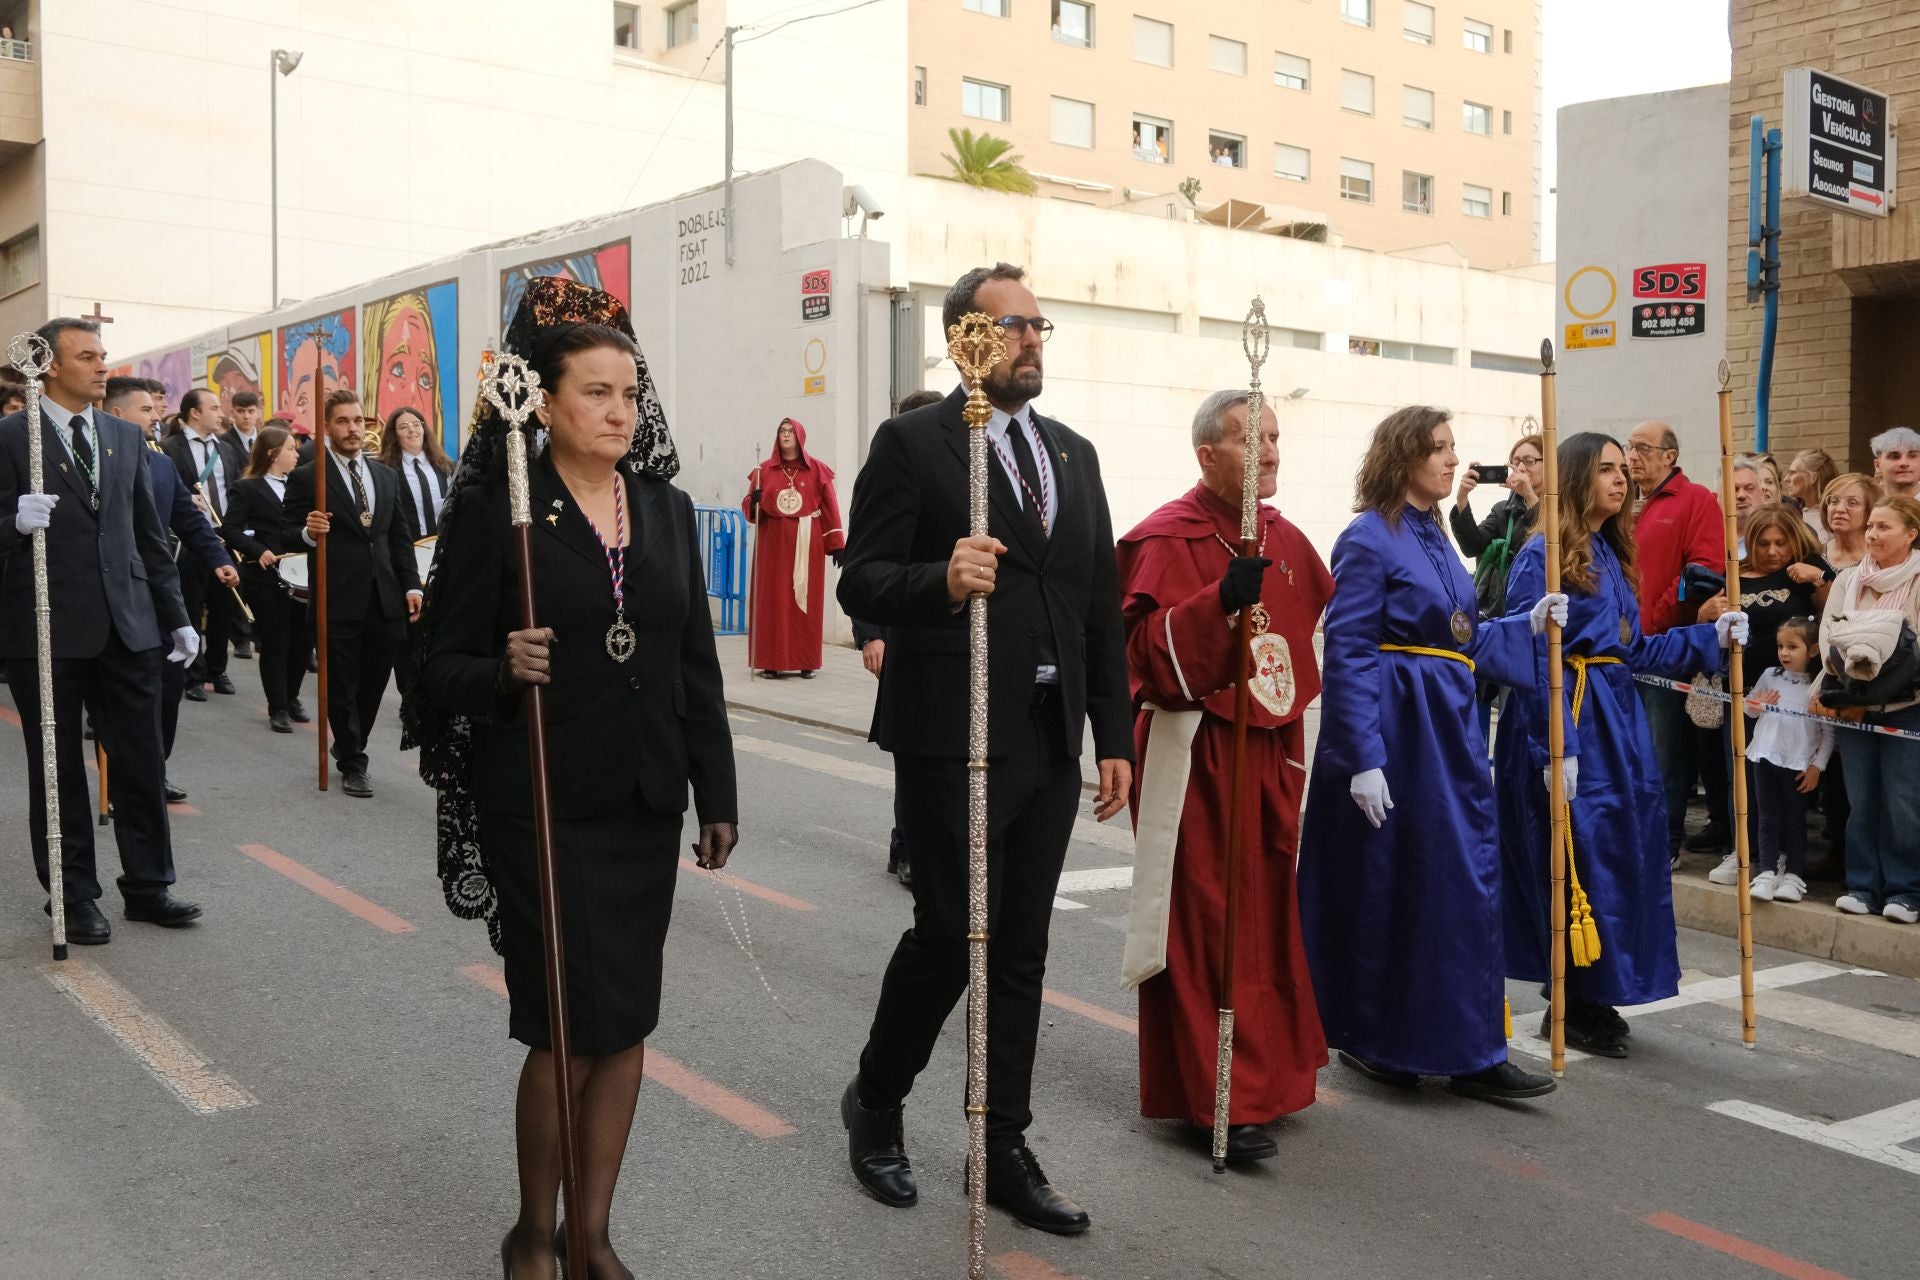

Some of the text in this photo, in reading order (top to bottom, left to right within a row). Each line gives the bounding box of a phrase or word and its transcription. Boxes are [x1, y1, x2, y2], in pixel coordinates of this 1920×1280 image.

[681, 261, 710, 285] 2022
[1639, 269, 1700, 296] SDS
[804, 276, 827, 291] SDS
[1641, 319, 1658, 329] 902
[1678, 317, 1695, 327] 458
